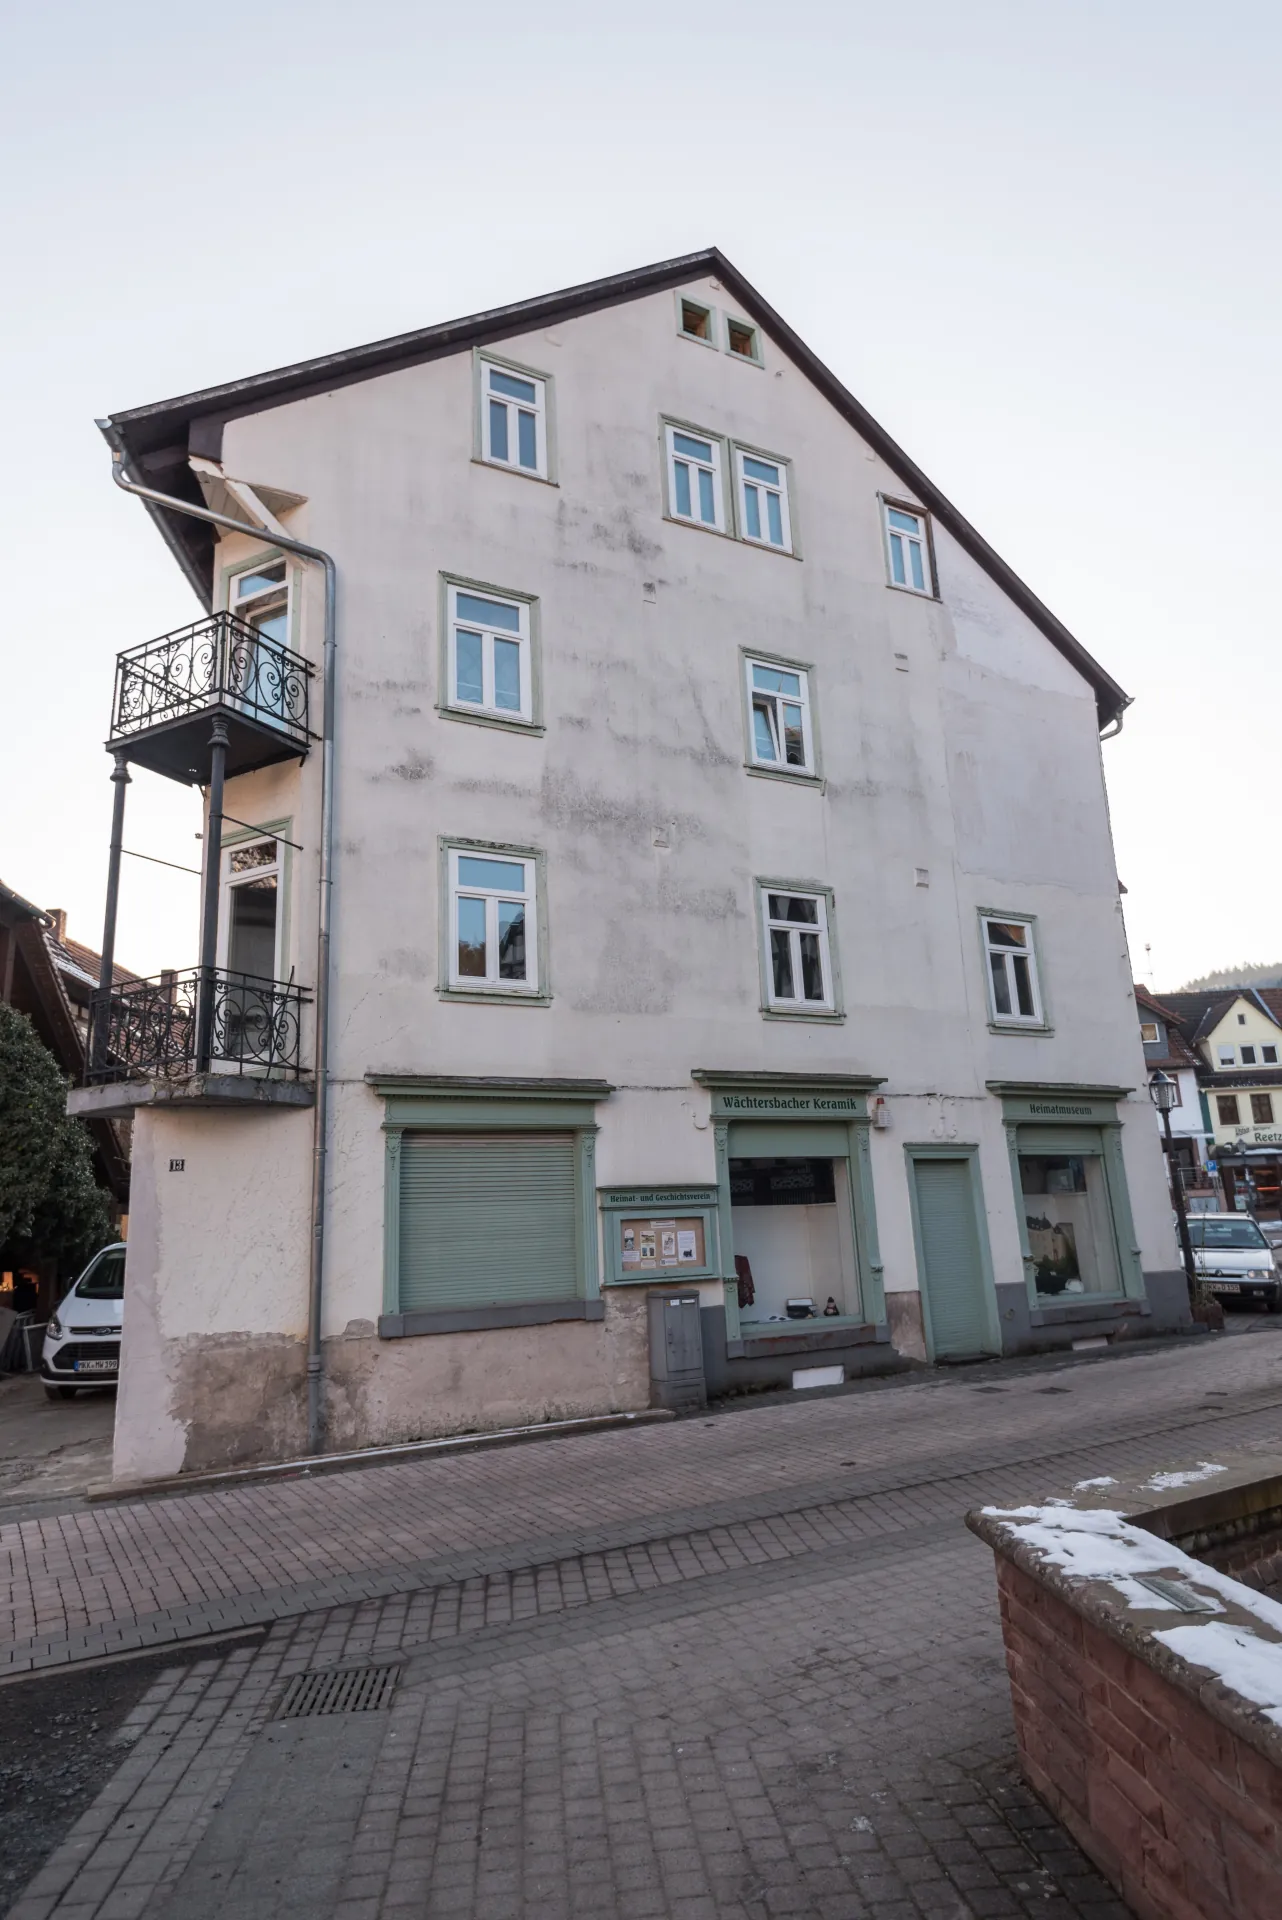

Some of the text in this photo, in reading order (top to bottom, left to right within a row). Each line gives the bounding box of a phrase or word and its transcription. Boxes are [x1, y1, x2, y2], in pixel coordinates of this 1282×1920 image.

[723, 1096, 857, 1110] Wächtersbacher Keramik
[1029, 1103, 1092, 1115] Heimatmuseum
[1254, 1132, 1282, 1142] Reetz
[172, 1160, 183, 1171] 13
[610, 1192, 711, 1203] Heimat- und Geschichtsverein
